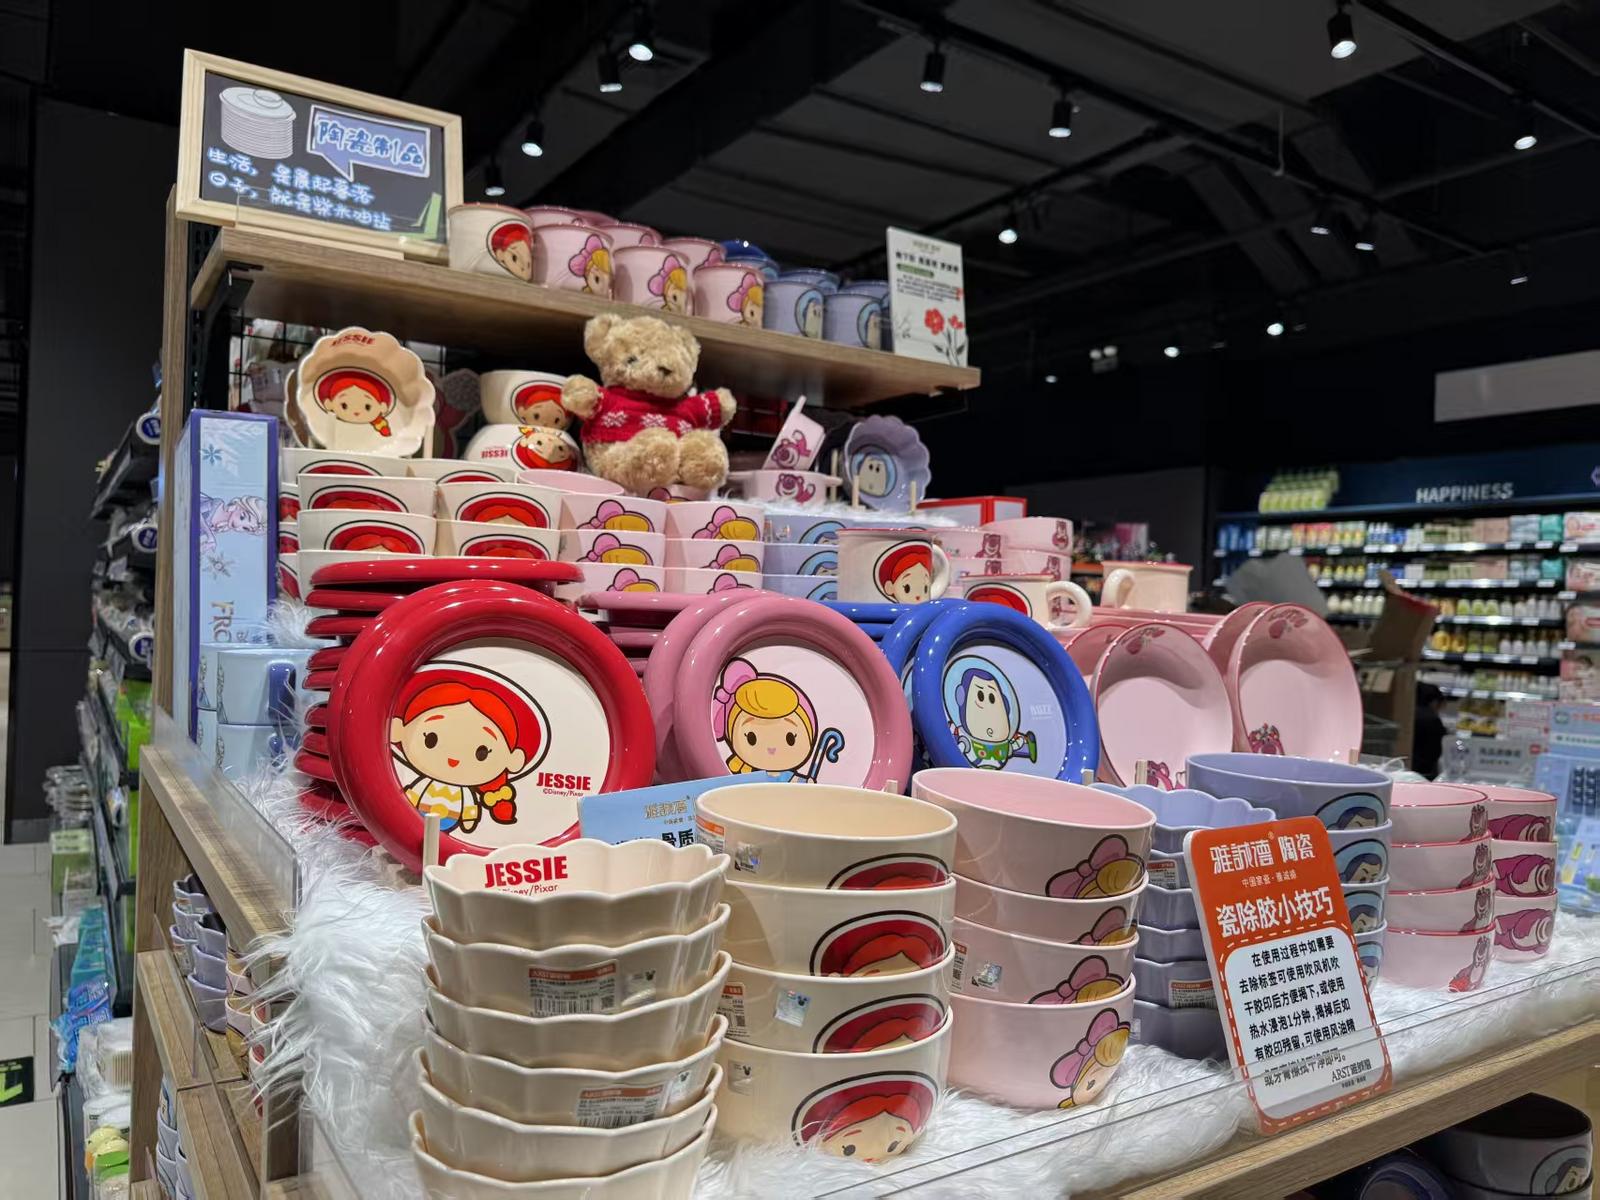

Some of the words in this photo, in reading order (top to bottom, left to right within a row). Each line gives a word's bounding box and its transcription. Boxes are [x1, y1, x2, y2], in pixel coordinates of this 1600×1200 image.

[316, 120, 425, 166] 陶瓷制品
[1416, 482, 1514, 503] HAPPINESS
[536, 772, 592, 791] JESSIE
[1278, 833, 1315, 863] 陶瓷
[485, 856, 568, 888] JESSIE
[1216, 886, 1334, 938] 瓷除胶小技巧
[1252, 935, 1335, 967] 在使用过程中如需要
[1239, 956, 1340, 994] 去除标签可使用吹风机吹
